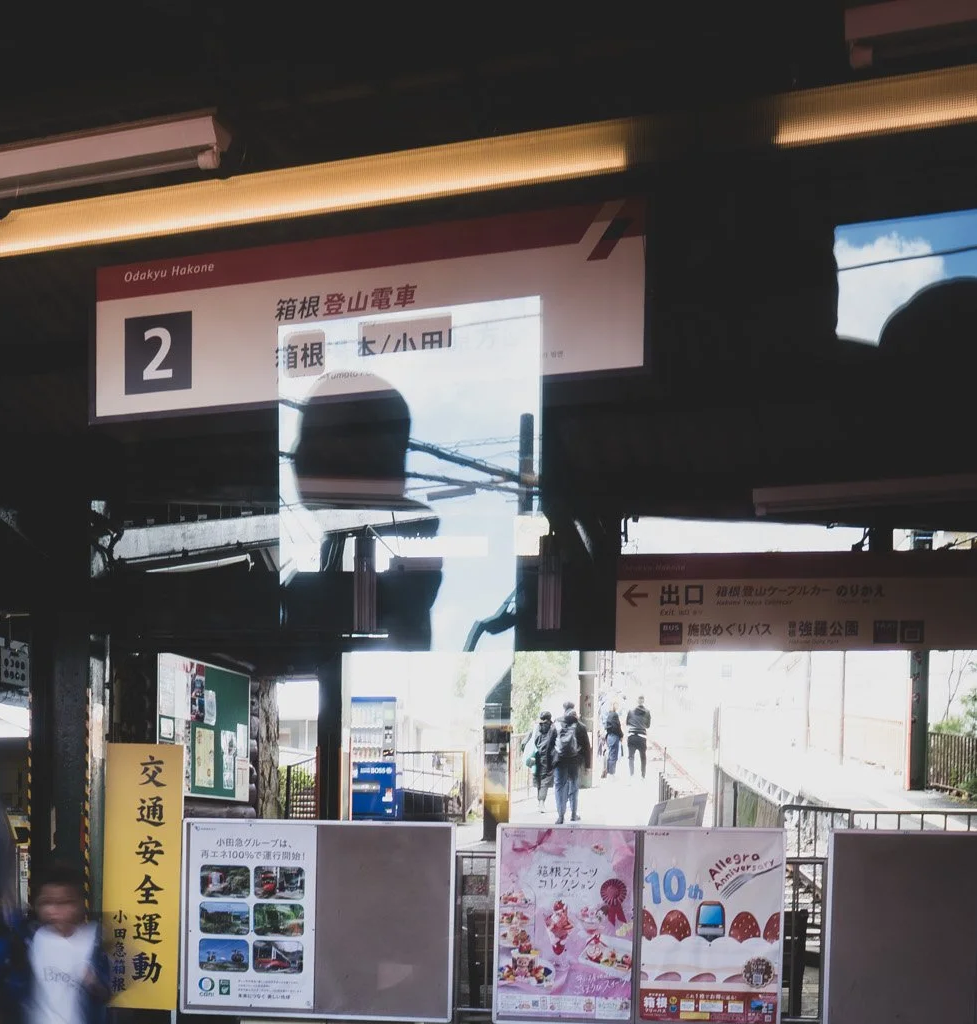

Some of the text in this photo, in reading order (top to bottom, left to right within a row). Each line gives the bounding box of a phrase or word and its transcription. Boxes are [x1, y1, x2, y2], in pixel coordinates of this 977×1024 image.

[124, 262, 215, 284] Odakyu Hakone
[275, 284, 417, 321] 箱根登山電車
[142, 325, 174, 381] 2
[660, 585, 704, 606] 出口
[716, 584, 885, 599] 箱根登山ケーブルカー のりかえ
[663, 624, 679, 632] BUS
[688, 623, 771, 637] 施設めぐりバス
[798, 620, 859, 637] 強羅公園
[131, 755, 167, 984] 交通安全運動
[537, 865, 598, 877] 箱根スイーツ
[709, 853, 760, 881] Allegro
[714, 859, 774, 891] Anniversary
[538, 879, 596, 890] コレクション
[645, 866, 704, 905] 10th
[112, 909, 128, 993] 小田急箱根
[644, 996, 668, 1008] 箱根
